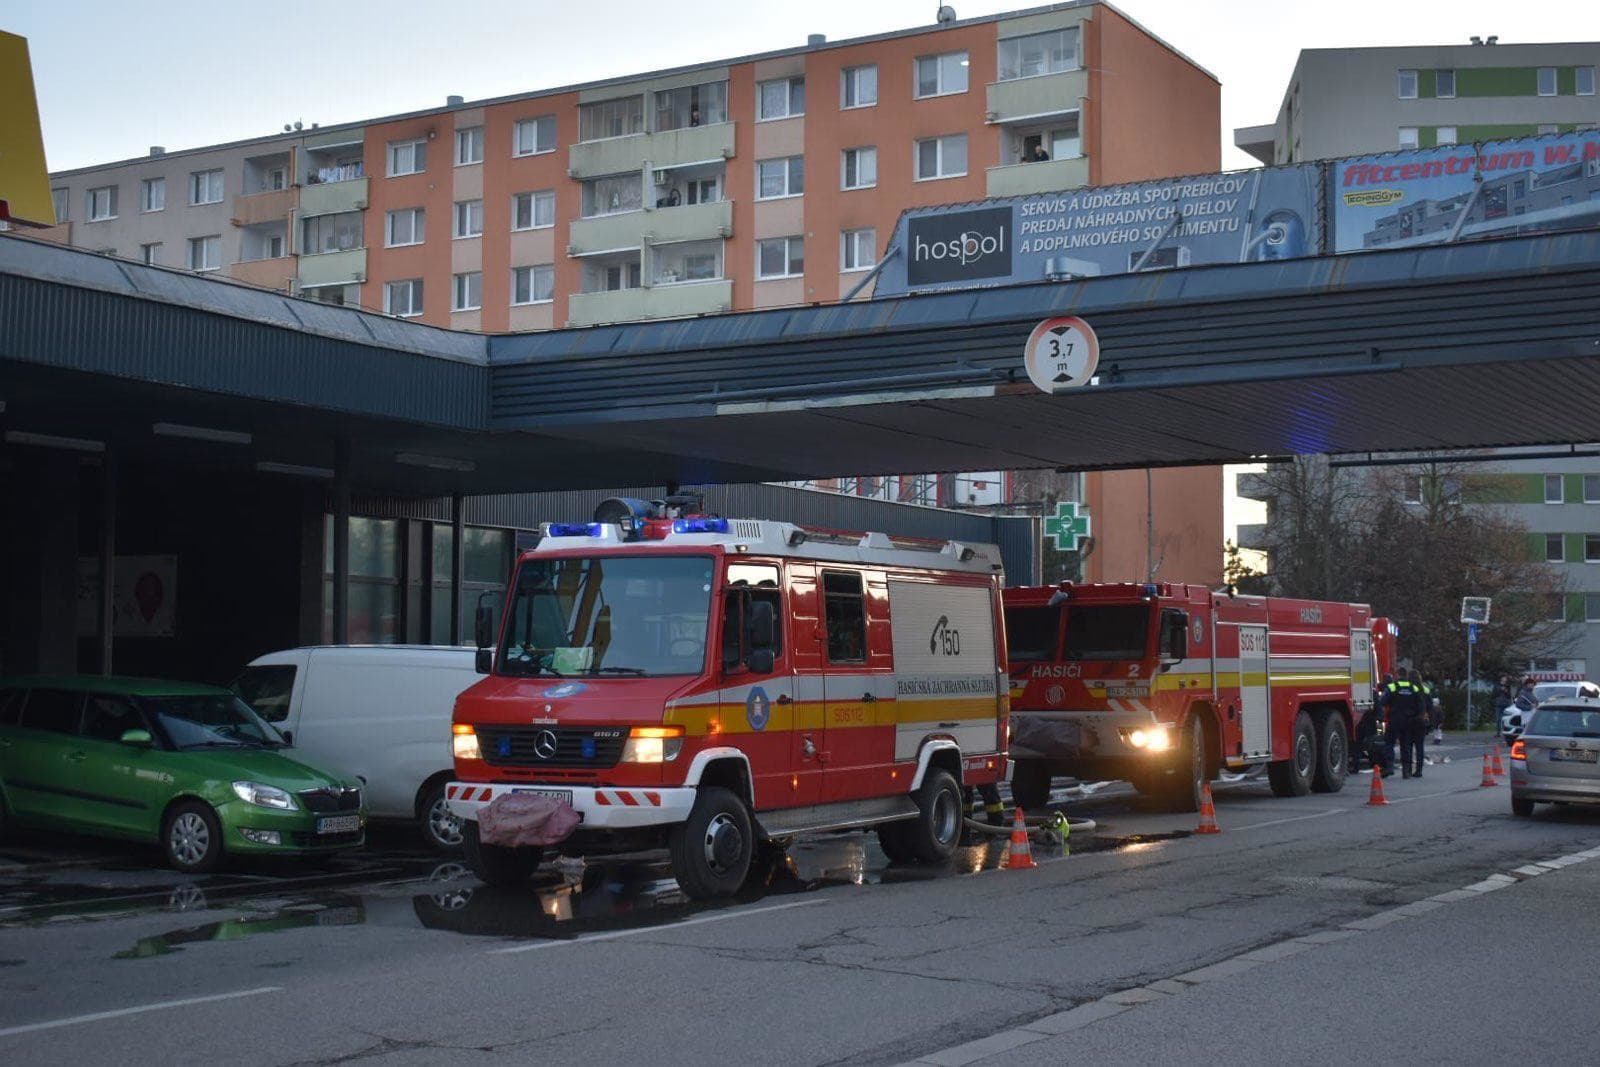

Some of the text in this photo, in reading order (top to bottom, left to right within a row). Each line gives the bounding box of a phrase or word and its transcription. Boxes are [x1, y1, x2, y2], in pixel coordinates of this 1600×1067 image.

[1021, 177, 1248, 217] SERVIS A ÚDRŽBA SPOTREBIČOV
[1021, 199, 1238, 236] PREDAJ NÁHRADNÝCH DIELOV
[915, 225, 1004, 266] hospol
[1020, 240, 1031, 253] A
[1033, 227, 1140, 252] DOPLNKOVÉHO
[1049, 339, 1074, 359] 3,7
[1057, 362, 1068, 371] m
[939, 629, 960, 656] 150
[1240, 633, 1266, 652] SOS 112
[1031, 662, 1082, 678] HASIČI
[1127, 663, 1140, 678] 2
